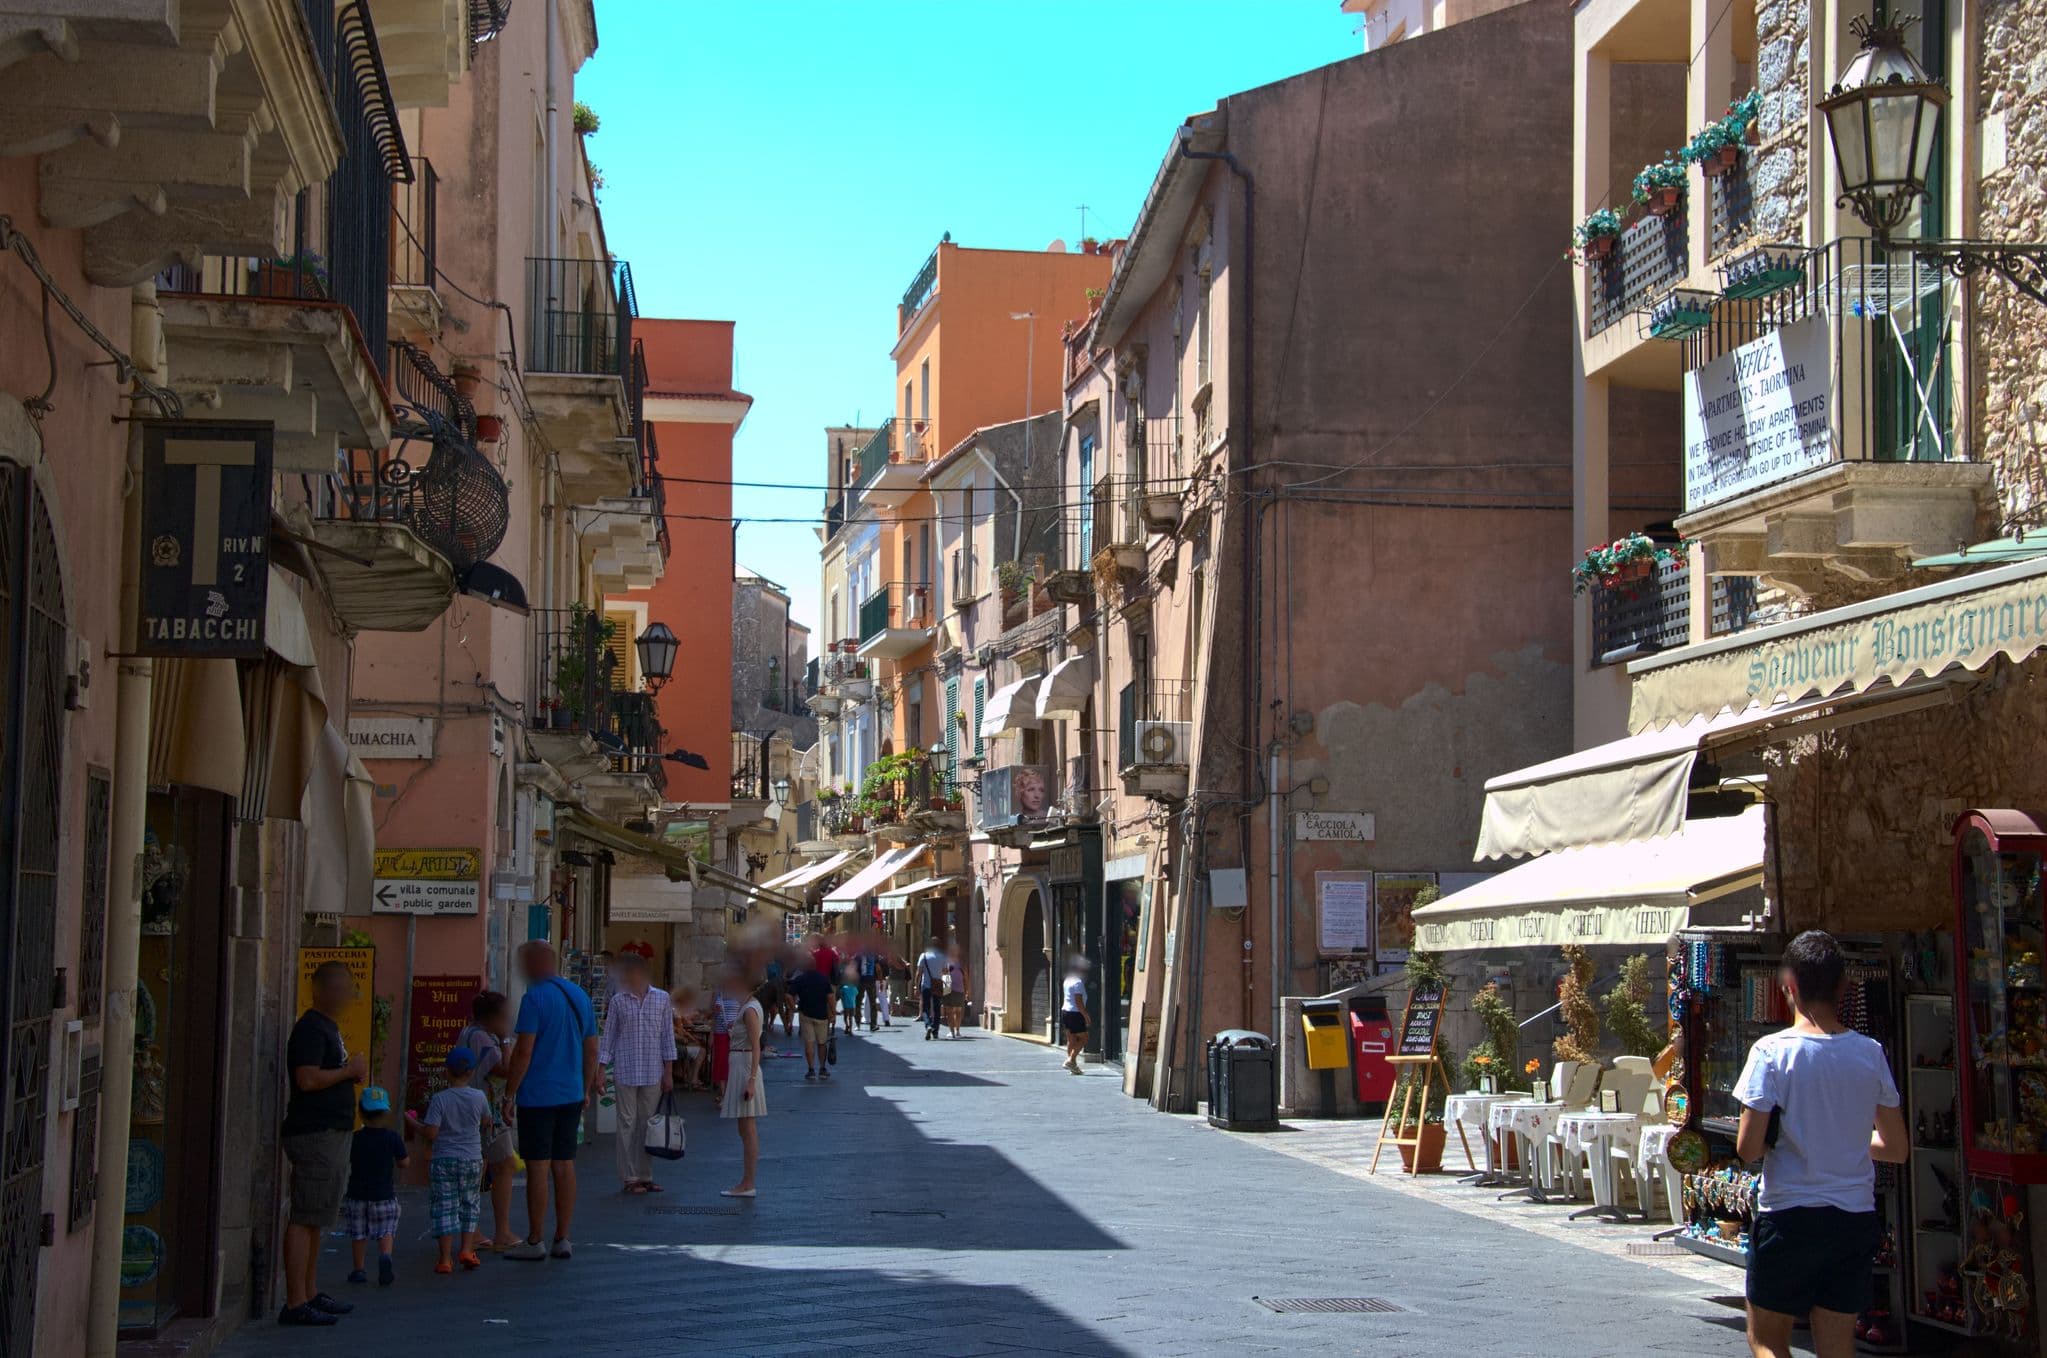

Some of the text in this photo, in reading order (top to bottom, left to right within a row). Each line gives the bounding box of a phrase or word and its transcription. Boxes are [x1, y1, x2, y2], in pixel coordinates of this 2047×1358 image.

[1732, 343, 1773, 383] OFFICE
[1703, 363, 1805, 420] APARTMENTS TAORMINA
[1689, 395, 1825, 460] WE PROVIDE HOLIDAY APARTMENTS
[1743, 436, 1773, 460] OUTSIDE
[1776, 431, 1786, 448] OF
[1789, 416, 1827, 443] TAORMINA
[1689, 488, 1701, 501] FOR
[1702, 480, 1718, 496] MORE
[1720, 467, 1758, 489] INFORMATION
[1759, 460, 1769, 474] GO
[1771, 457, 1780, 470] UP
[1783, 452, 1792, 465] TO
[1804, 439, 1827, 459] FLOOR
[164, 439, 256, 585] T
[223, 537, 249, 553] RIV.
[233, 563, 245, 582] 2
[146, 617, 258, 641] TABACCHI
[1746, 635, 1859, 696] Souvenir
[1306, 820, 1356, 830] CACCIOLA
[1318, 829, 1364, 839] CAMIOLA
[400, 884, 476, 895] villa comunale
[403, 899, 472, 909] public garden
[304, 951, 368, 959] PASTICCERIA
[431, 990, 458, 1003] Vini
[420, 1015, 468, 1029] Liquori
